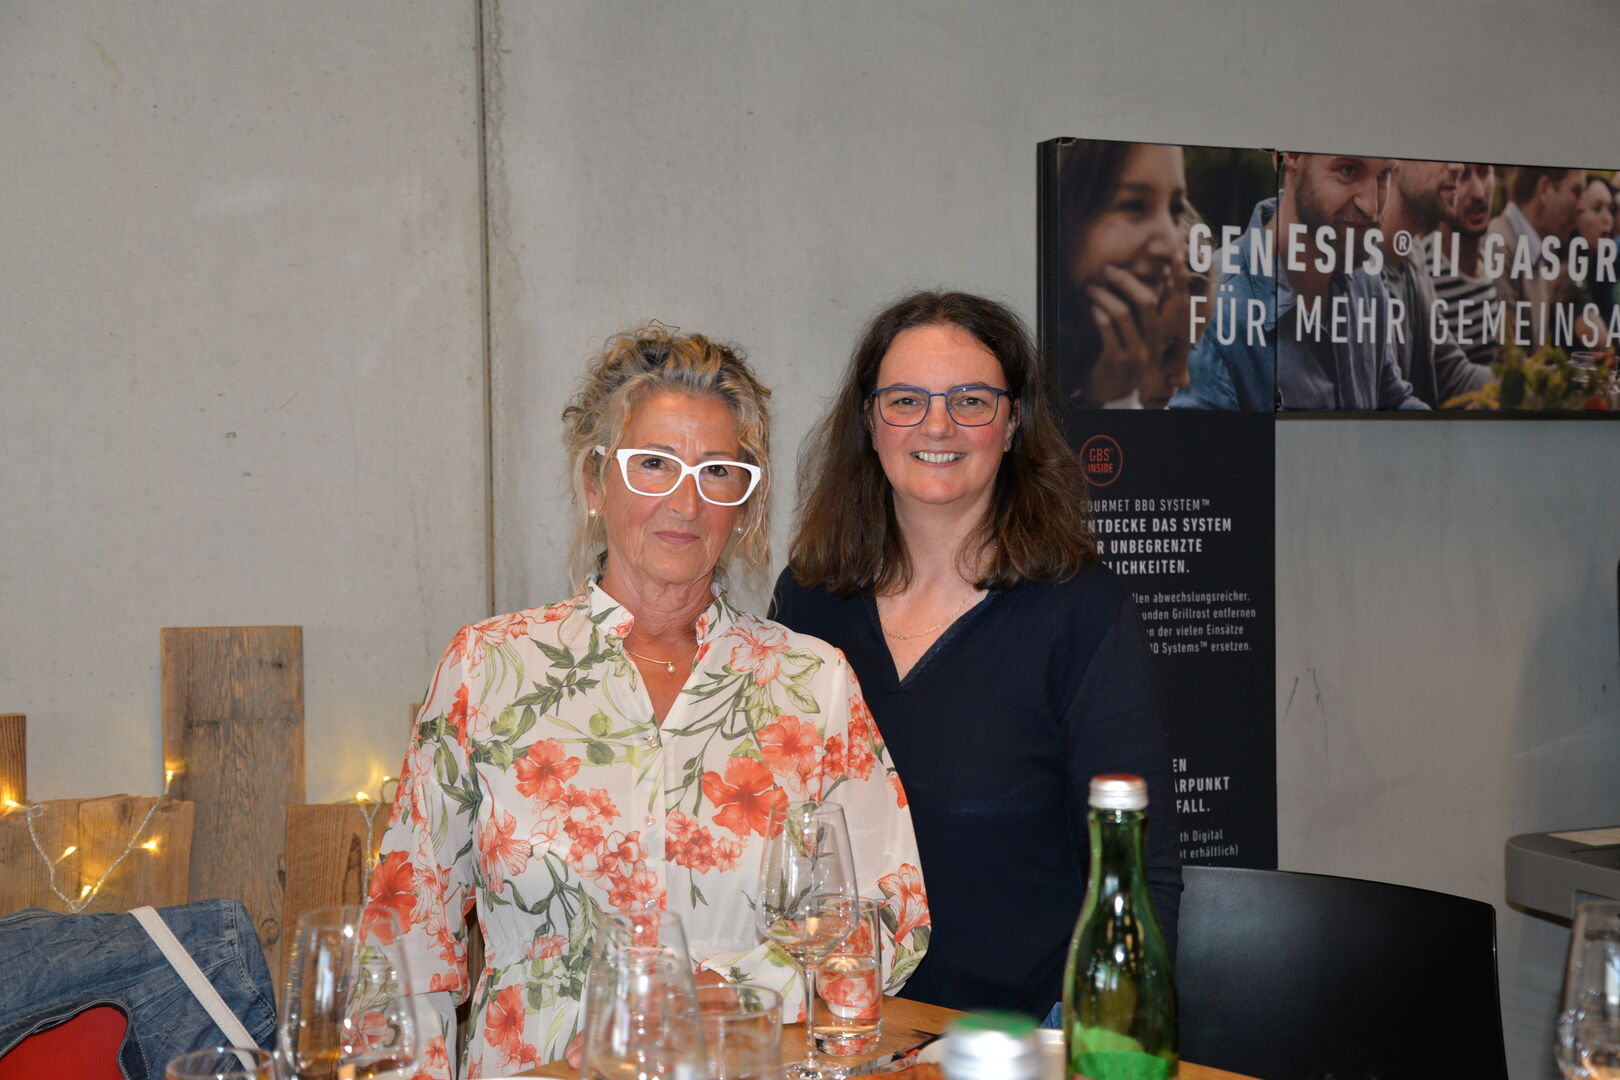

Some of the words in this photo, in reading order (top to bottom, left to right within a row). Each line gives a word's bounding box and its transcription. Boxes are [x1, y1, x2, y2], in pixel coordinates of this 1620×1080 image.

[1432, 231, 1460, 278] II
[1483, 232, 1618, 283] GASGR
[1189, 284, 1267, 348] FÜR
[1296, 294, 1406, 345] MEHR
[1087, 463, 1114, 474] INSIDE
[1134, 498, 1156, 512] BBQ
[1160, 498, 1210, 512] SYSTEM™
[1152, 517, 1178, 532] DAS
[1183, 517, 1232, 532] SYSTEM
[1111, 538, 1203, 555] UNBEGRENZTE
[1153, 590, 1250, 605] abwechslungsreicher.
[1172, 607, 1210, 620] Grillrost
[1213, 607, 1256, 619] entfernen
[1157, 625, 1173, 637] der
[1175, 624, 1204, 637] vielen
[1206, 623, 1244, 636] Einsätze
[1210, 641, 1252, 653] ersetzen.
[1176, 798, 1211, 814] FALL.
[1192, 829, 1223, 844] Digital
[1190, 843, 1239, 860] erhältlich)
